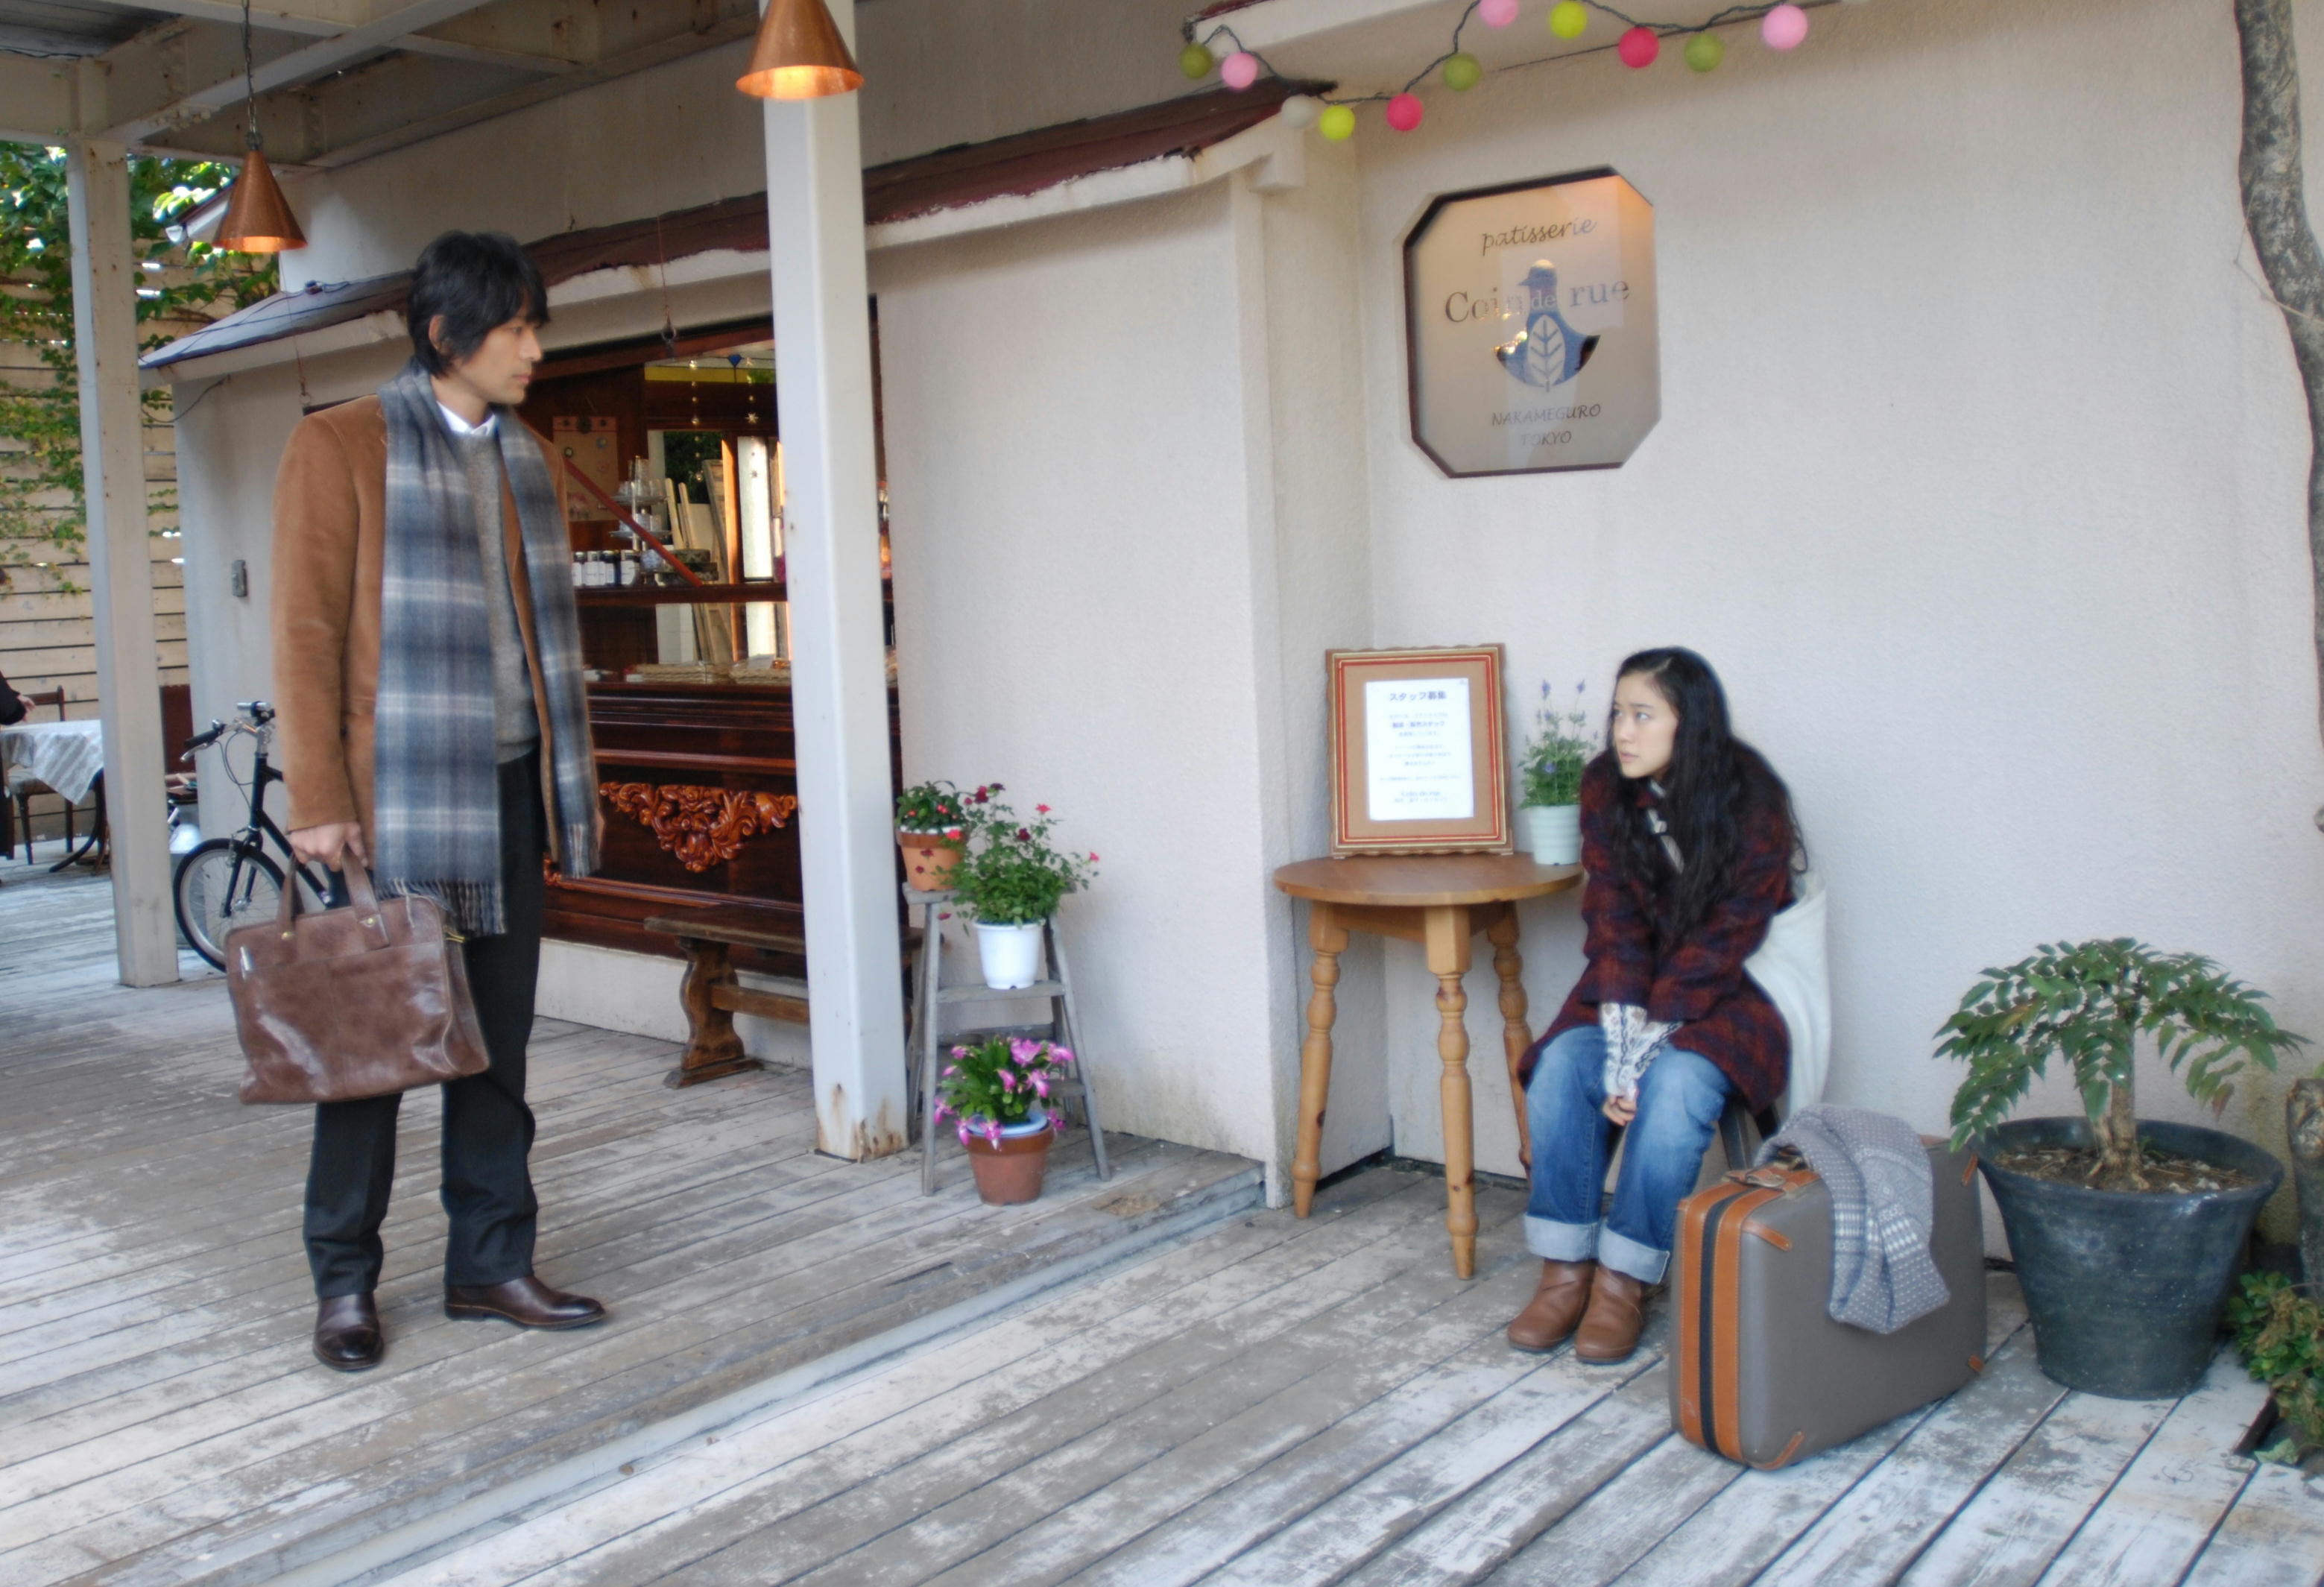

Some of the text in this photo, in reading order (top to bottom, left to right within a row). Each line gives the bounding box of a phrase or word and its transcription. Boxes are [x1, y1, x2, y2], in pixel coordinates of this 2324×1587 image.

[1482, 216, 1598, 256] patisserie
[1444, 280, 1630, 323] Coin de rue
[1491, 403, 1601, 426] NAKAMEGURO
[1521, 430, 1572, 447] TOKYO
